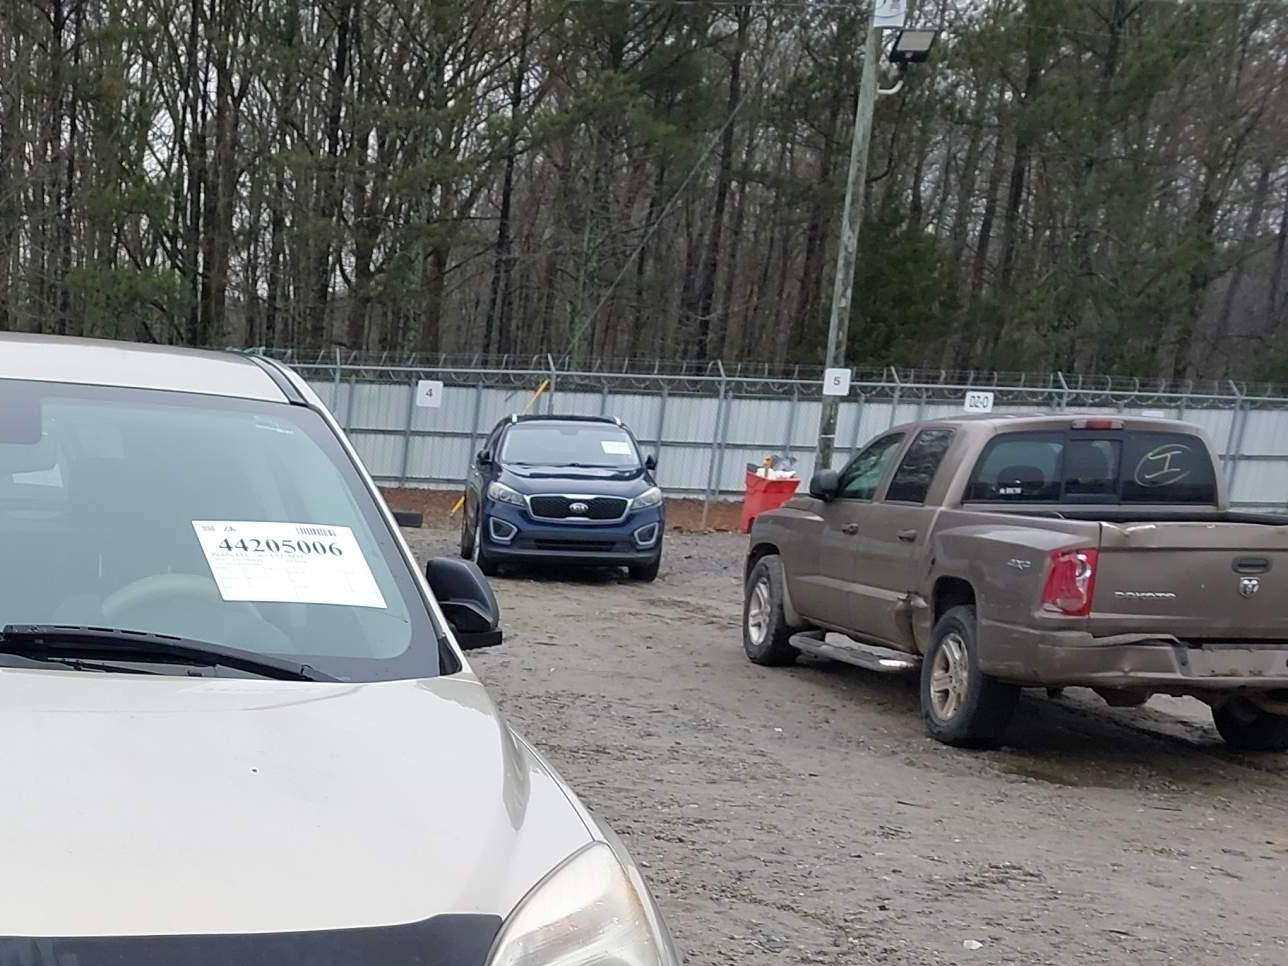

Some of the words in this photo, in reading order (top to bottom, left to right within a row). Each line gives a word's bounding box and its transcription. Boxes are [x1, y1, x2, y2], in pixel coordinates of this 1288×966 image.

[833, 375, 841, 386] 5
[425, 388, 433, 398] 4
[218, 538, 343, 557] 44205006
